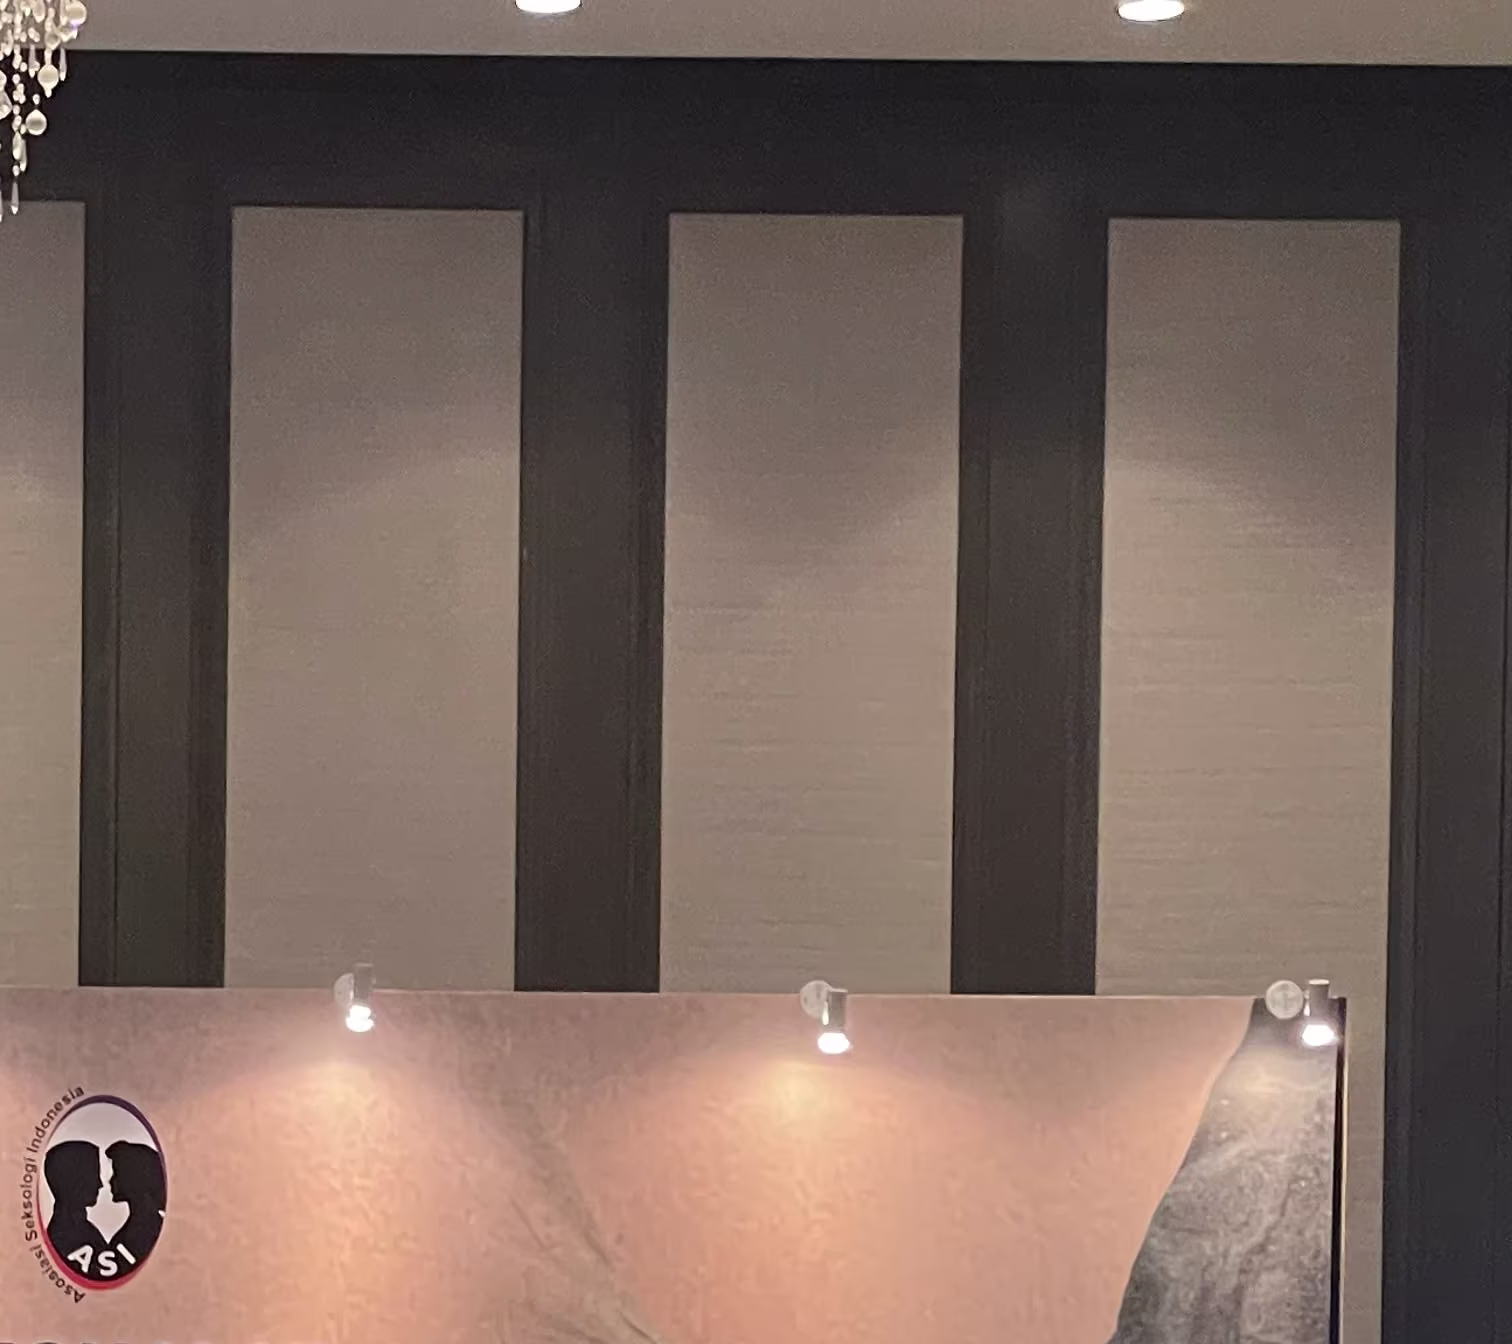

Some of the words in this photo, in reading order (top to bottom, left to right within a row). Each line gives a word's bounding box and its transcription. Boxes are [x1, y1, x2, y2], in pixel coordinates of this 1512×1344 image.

[26, 1086, 85, 1155] Indonesia
[19, 1157, 38, 1242] Seksologi
[29, 1244, 86, 1304] Asosiasi
[67, 1243, 137, 1277] ASI
